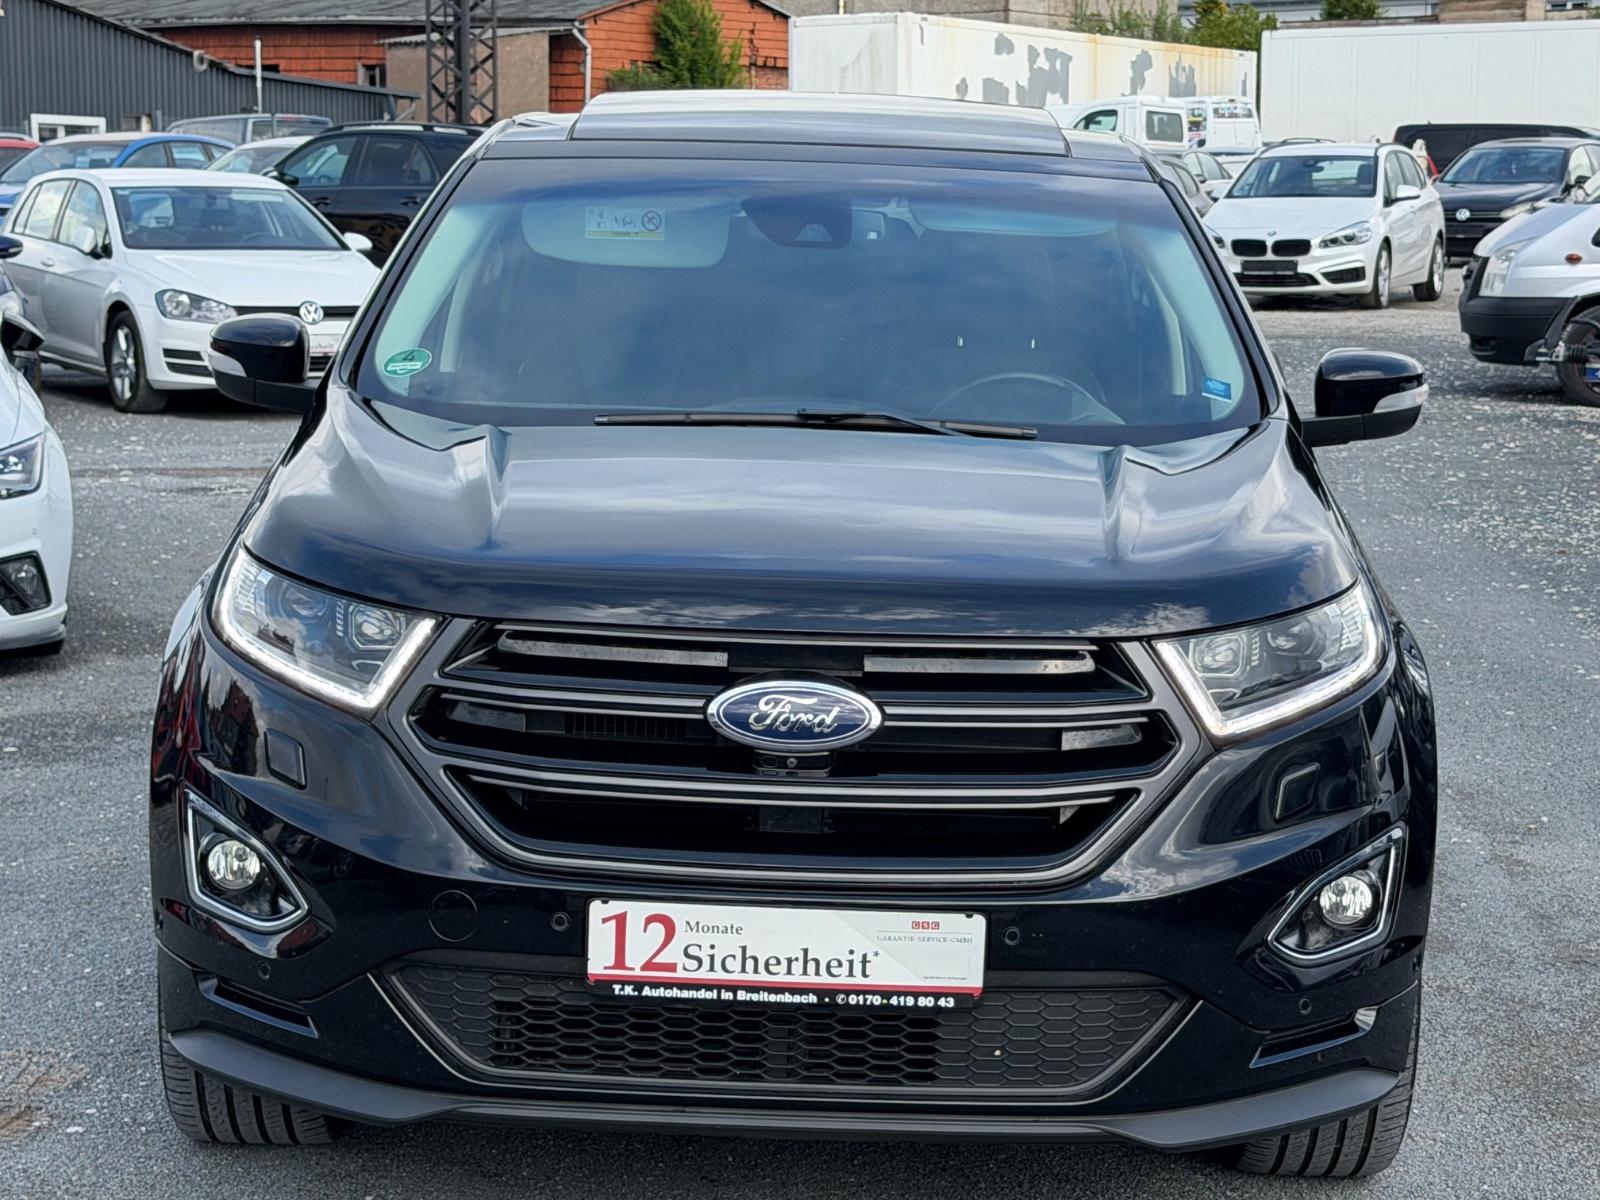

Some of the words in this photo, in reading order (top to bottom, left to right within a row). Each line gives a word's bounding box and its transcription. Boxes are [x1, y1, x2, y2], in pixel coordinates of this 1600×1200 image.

[748, 694, 841, 733] Ford
[601, 910, 678, 973] 12
[684, 919, 744, 935] Monate
[612, 984, 639, 996] T.K.
[641, 985, 718, 1000] Autohandel
[720, 988, 734, 1000] in
[736, 990, 818, 1003] Breitenbach
[917, 995, 935, 1007] 80
[937, 996, 955, 1008] 43
